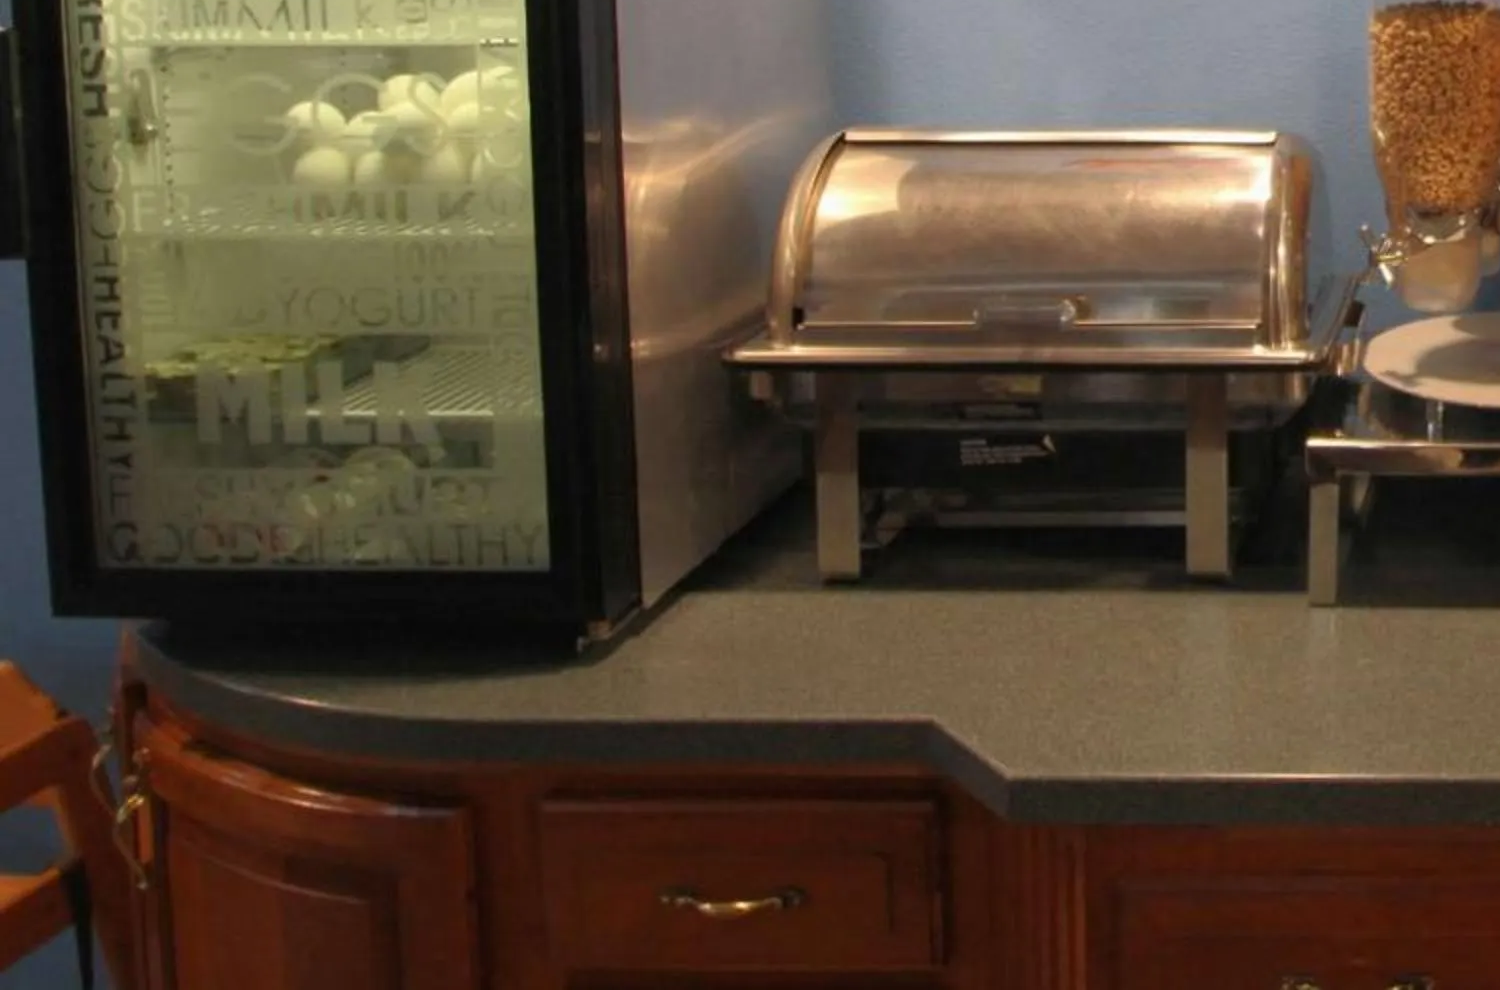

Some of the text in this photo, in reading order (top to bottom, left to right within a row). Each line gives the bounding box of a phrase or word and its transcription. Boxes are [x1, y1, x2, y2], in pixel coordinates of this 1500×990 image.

[276, 285, 481, 330] YOGURT
[94, 274, 134, 470] HEALTHY
[195, 358, 446, 452] MILK
